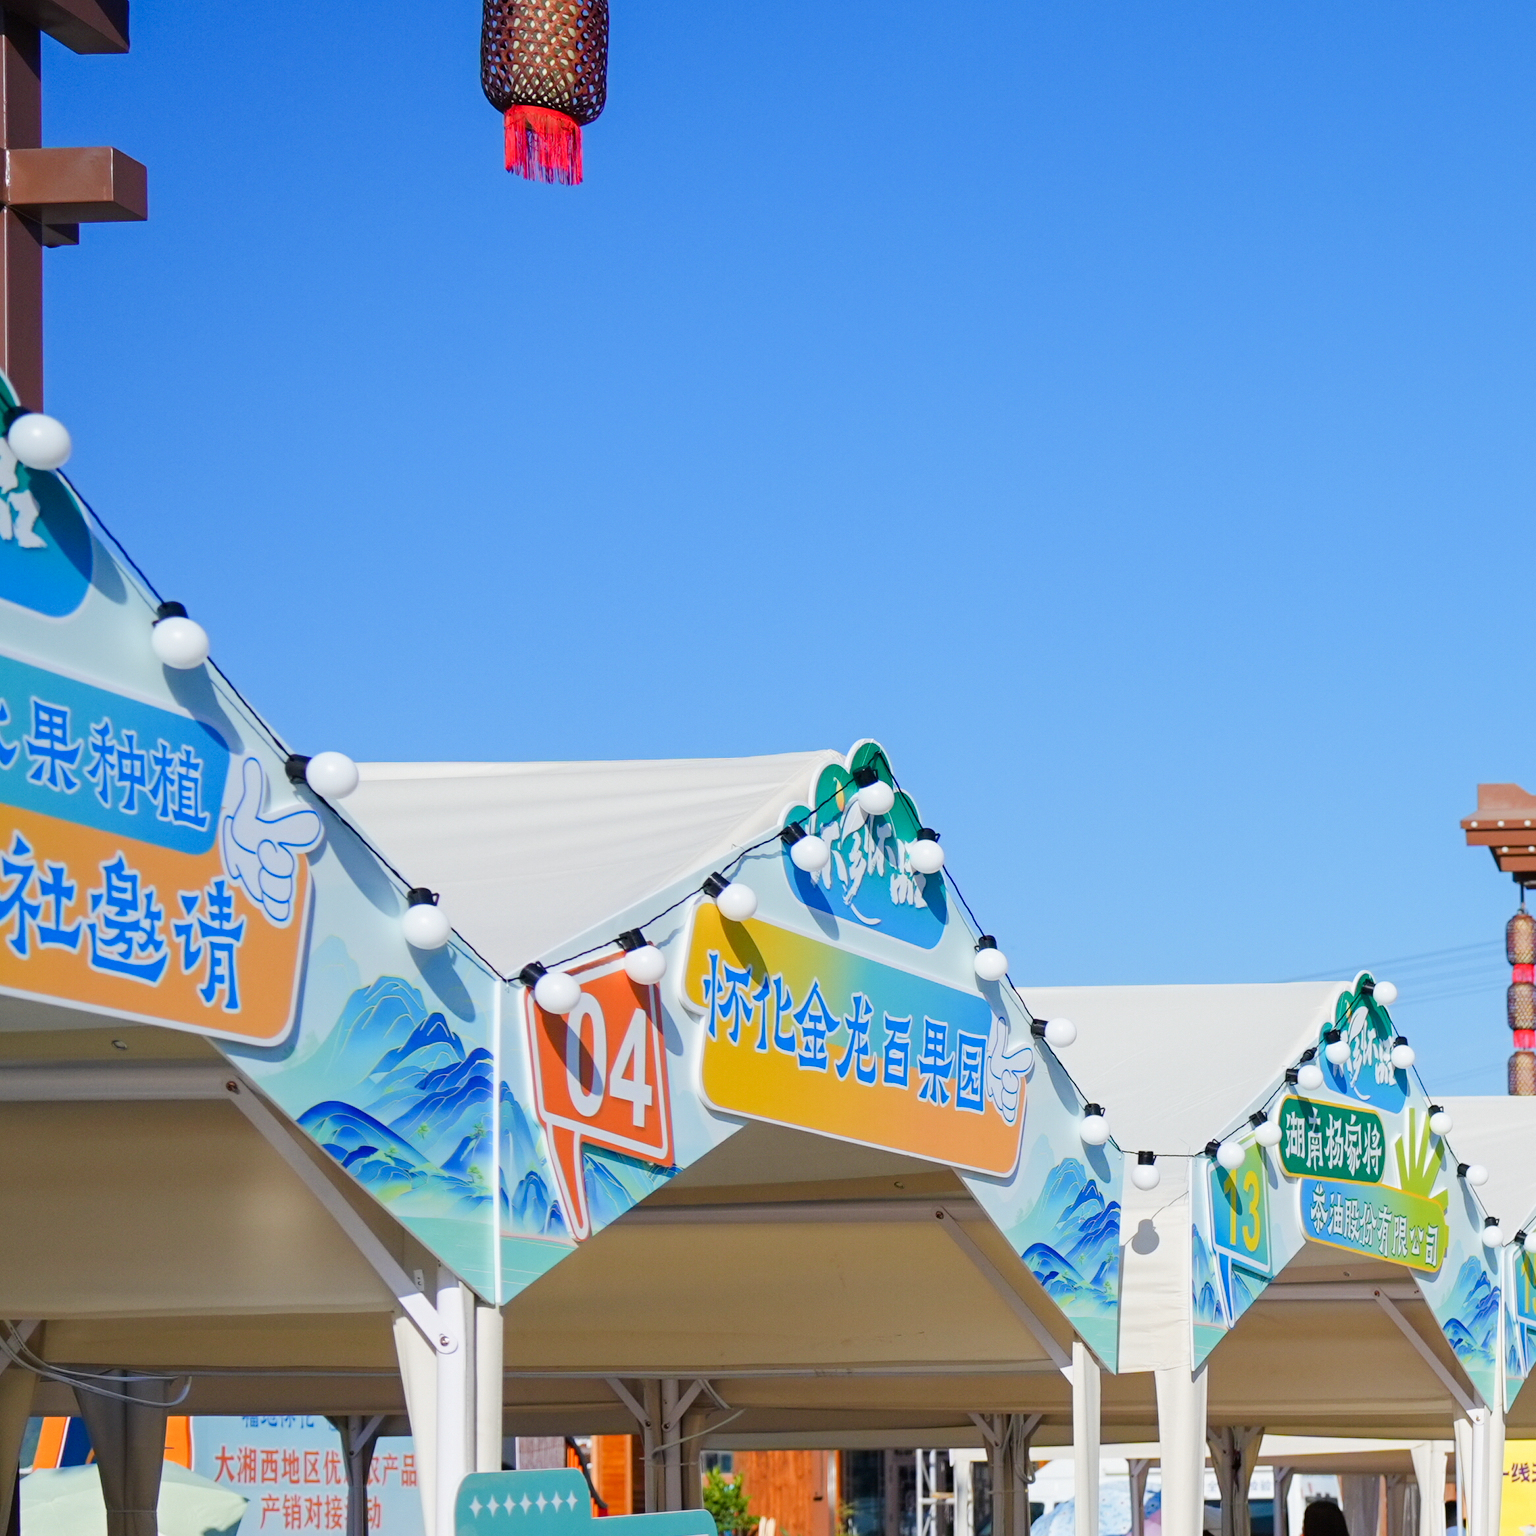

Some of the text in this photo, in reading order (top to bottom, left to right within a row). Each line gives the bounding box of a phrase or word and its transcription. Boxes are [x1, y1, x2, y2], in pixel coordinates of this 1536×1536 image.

[565, 1000, 653, 1130] 04
[702, 948, 989, 1113] 怀化金龙百果园
[1285, 1108, 1382, 1176] 湖南杨家将
[1222, 1168, 1261, 1253] 13
[214, 1445, 418, 1487] 大湘西地区优农产品
[260, 1494, 383, 1530] 产销对接动
